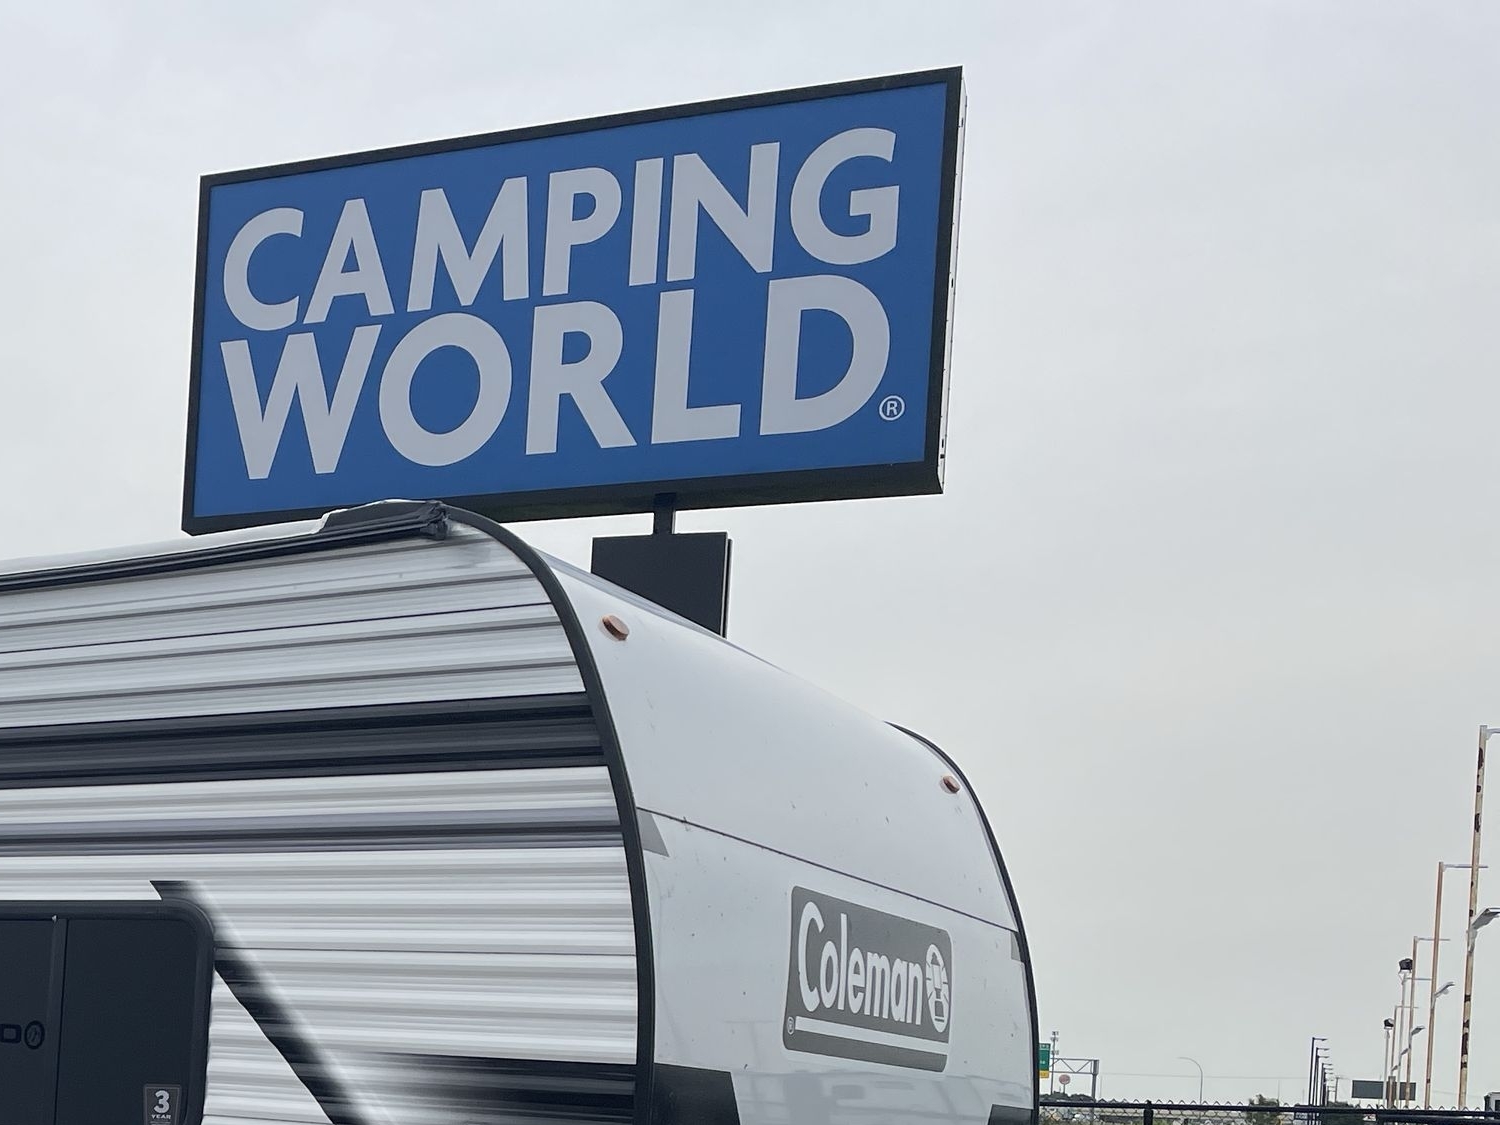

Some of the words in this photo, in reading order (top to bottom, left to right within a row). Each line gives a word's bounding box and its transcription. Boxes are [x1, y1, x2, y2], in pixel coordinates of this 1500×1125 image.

[223, 127, 900, 331] CAMPING
[220, 274, 891, 481] WORLD
[798, 901, 924, 1025] Coleman
[153, 1090, 170, 1114] 3
